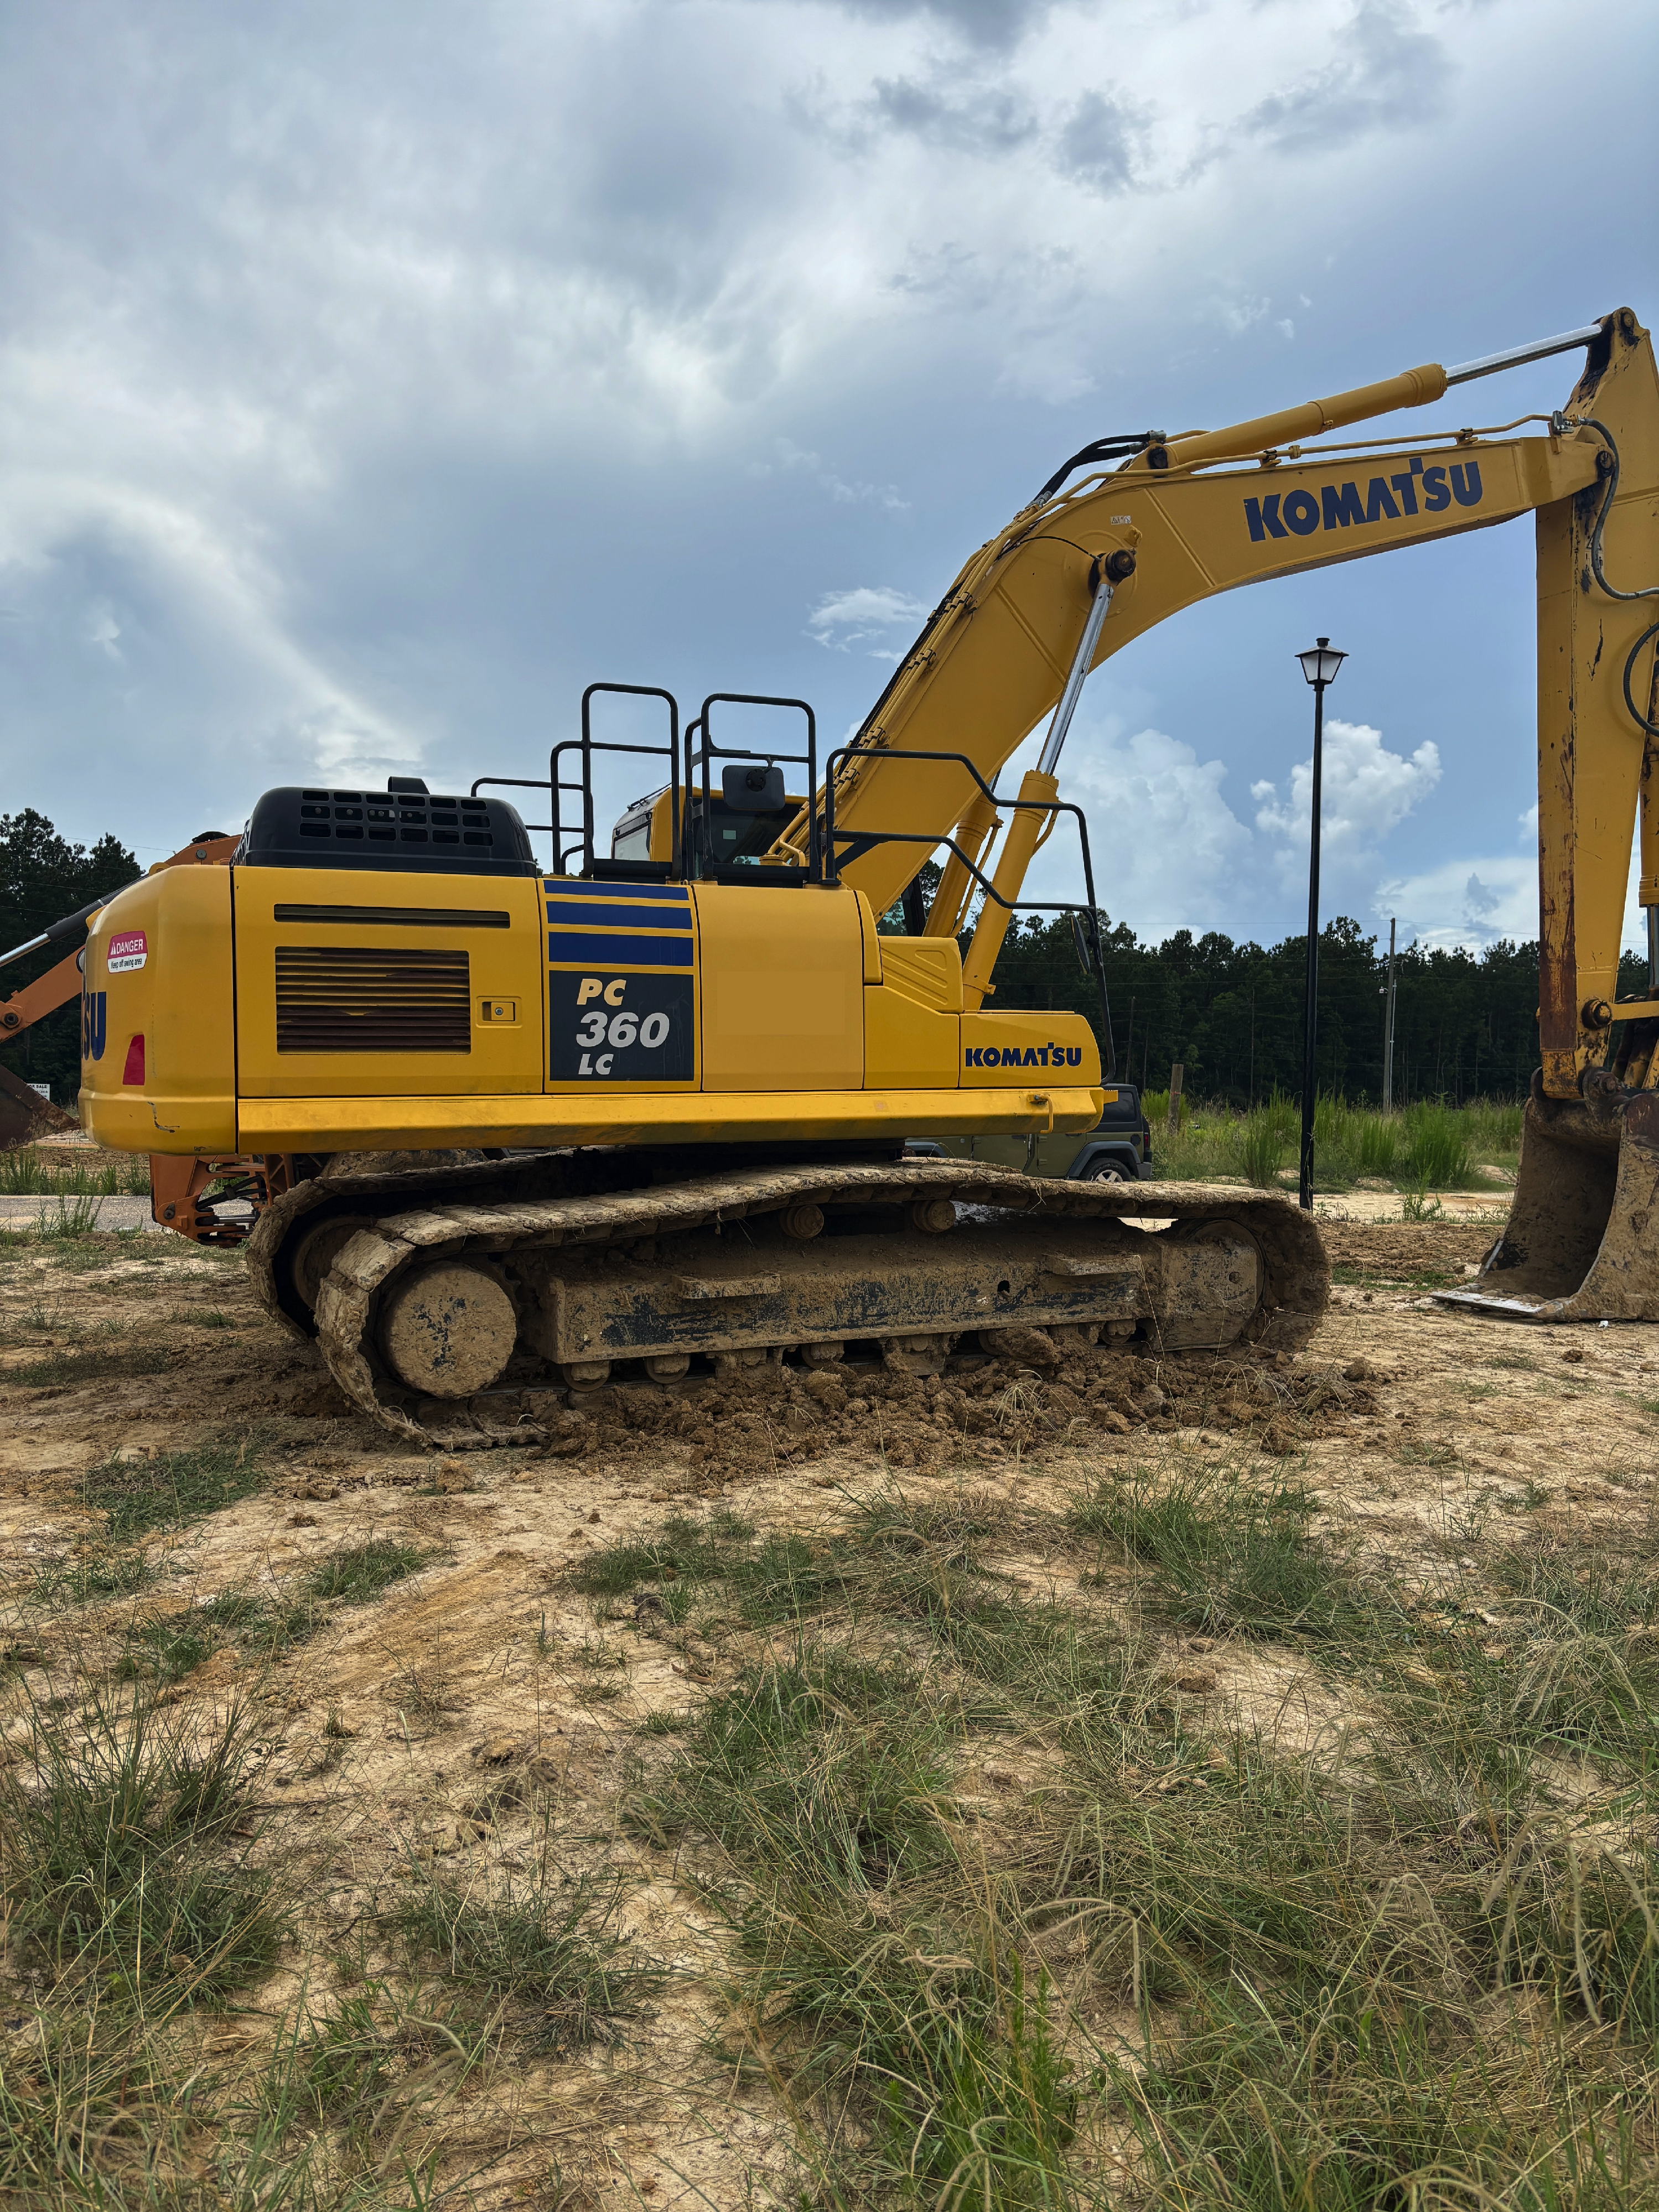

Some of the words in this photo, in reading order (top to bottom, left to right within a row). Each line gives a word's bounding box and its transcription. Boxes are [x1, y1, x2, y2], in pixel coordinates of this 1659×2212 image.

[1243, 457, 1483, 542] KOMATSU
[116, 939, 143, 954] DANGER
[577, 978, 626, 1006] PC
[576, 1011, 670, 1048] 360
[578, 1053, 614, 1074] LC
[965, 1042, 1082, 1067] KOMATSU
